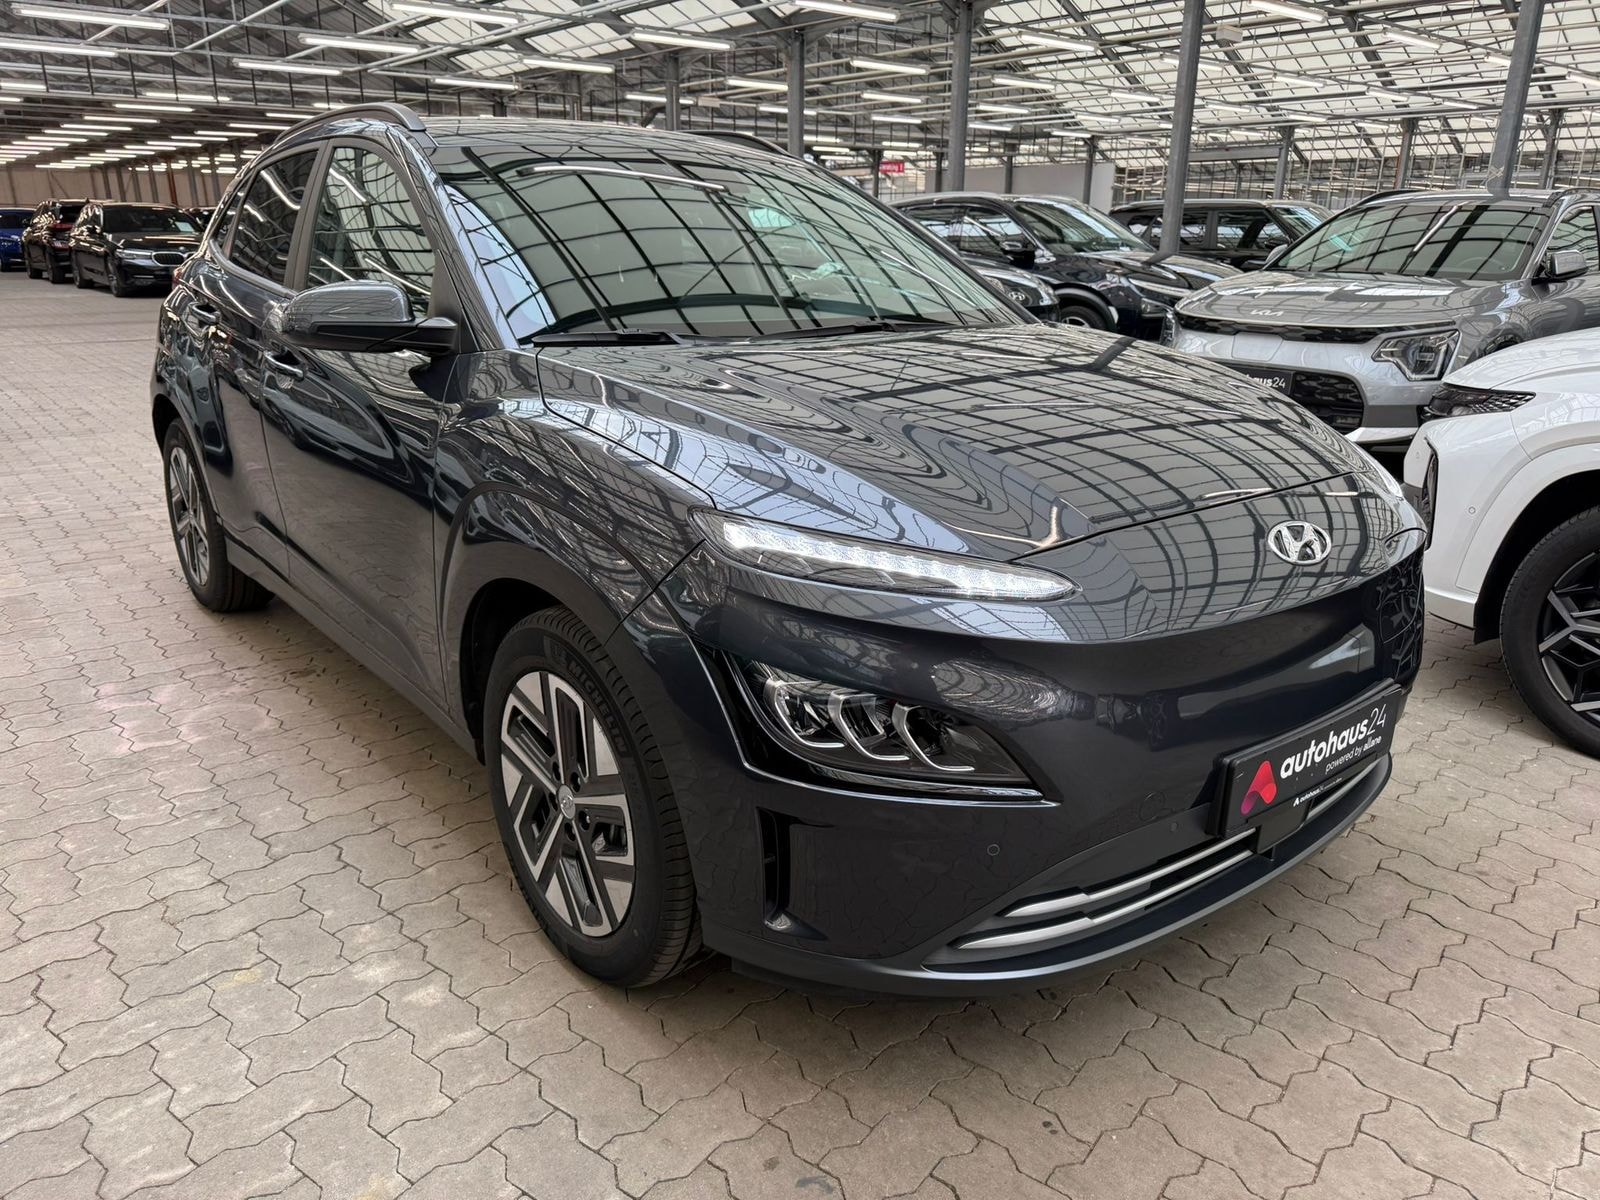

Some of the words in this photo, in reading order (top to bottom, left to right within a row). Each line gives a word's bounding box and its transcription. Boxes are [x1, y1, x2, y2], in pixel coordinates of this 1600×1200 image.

[567, 659, 628, 753] MICHELIN
[1280, 703, 1387, 779] autohaus24
[1325, 747, 1355, 775] powered
[1354, 744, 1363, 757] by
